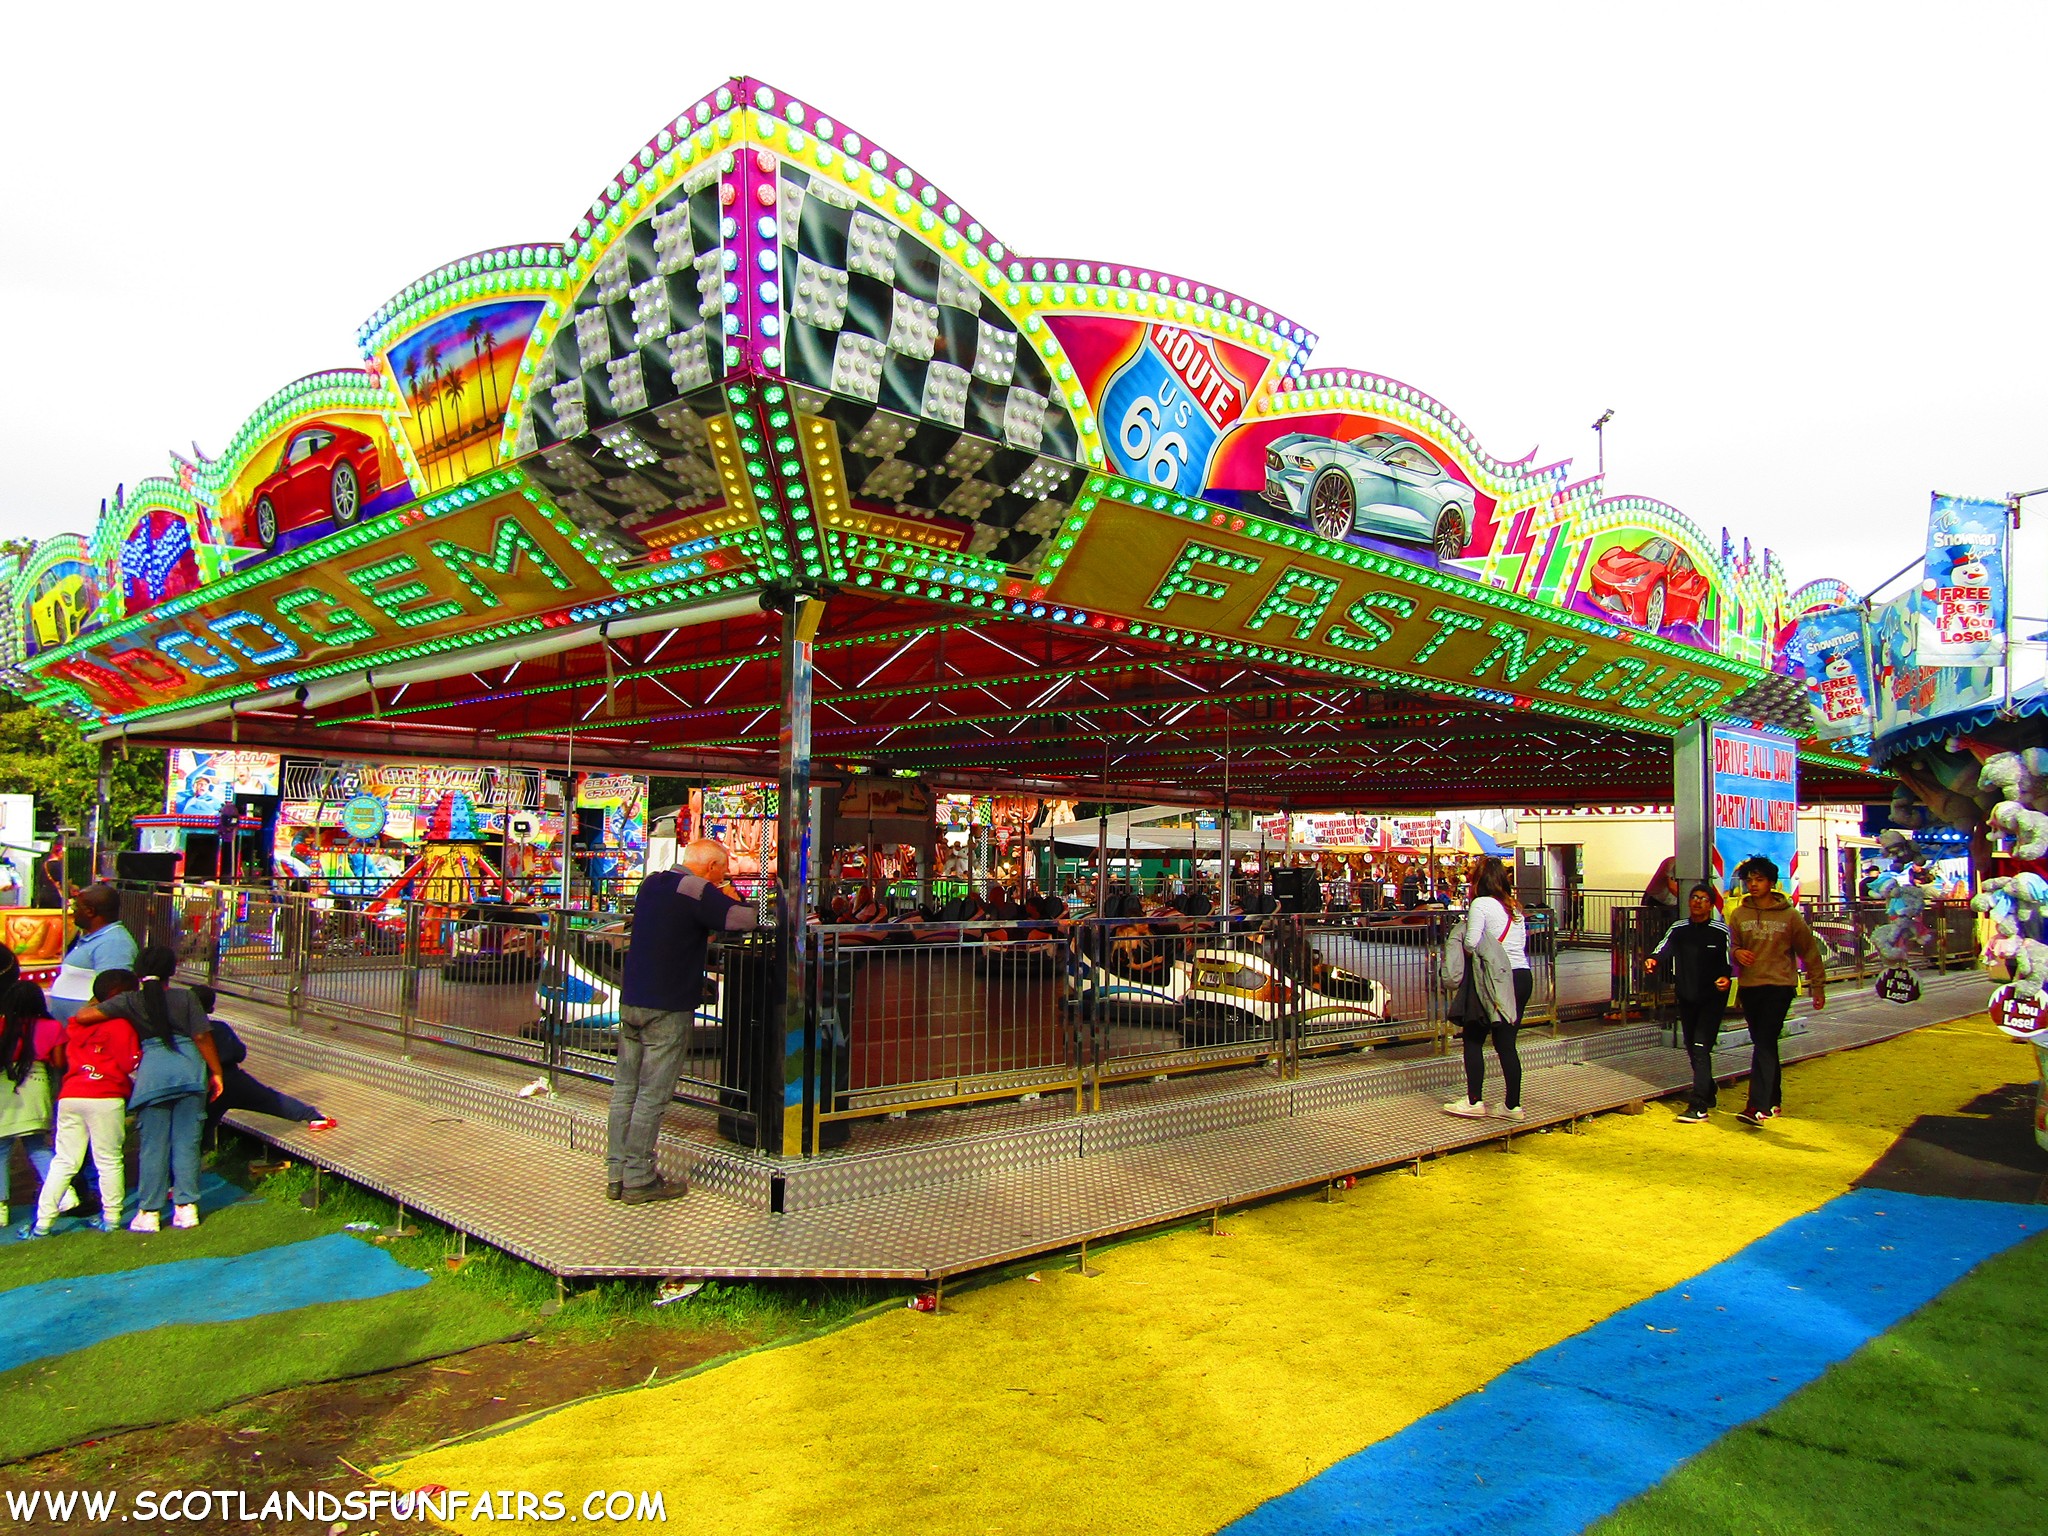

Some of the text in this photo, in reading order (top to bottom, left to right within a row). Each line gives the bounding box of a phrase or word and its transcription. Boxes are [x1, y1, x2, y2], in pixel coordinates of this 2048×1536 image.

[1155, 325, 1234, 423] ROUTE
[1120, 395, 1188, 491] 66
[1933, 531, 1997, 548] Snowman
[1939, 587, 1991, 601] FREE
[1942, 601, 1988, 615] Bear
[1936, 615, 1995, 629] If You
[1806, 631, 1859, 655] Snowman
[1940, 630, 1990, 643] Lose!
[1821, 675, 1857, 691] FREE
[1825, 687, 1857, 702] Bear
[1823, 696, 1865, 712] If You
[1827, 705, 1862, 722] Lose!
[1715, 737, 1794, 783] DRIVE ALL DAY
[584, 778, 616, 789] BEAT
[585, 787, 636, 799] GRAVITY
[1715, 793, 1795, 833] PARTY ALL NIGHT
[1314, 817, 1366, 829] ONE RING OVER
[1400, 819, 1441, 830] ONE RING OVER
[1336, 827, 1358, 835] BLOCK
[1406, 830, 1417, 838] THE
[1339, 835, 1354, 843] WIN
[1886, 978, 1911, 991] If You
[1886, 989, 1909, 1001] Lose!
[2003, 999, 2038, 1016] If You
[2003, 1014, 2035, 1029] Lose!
